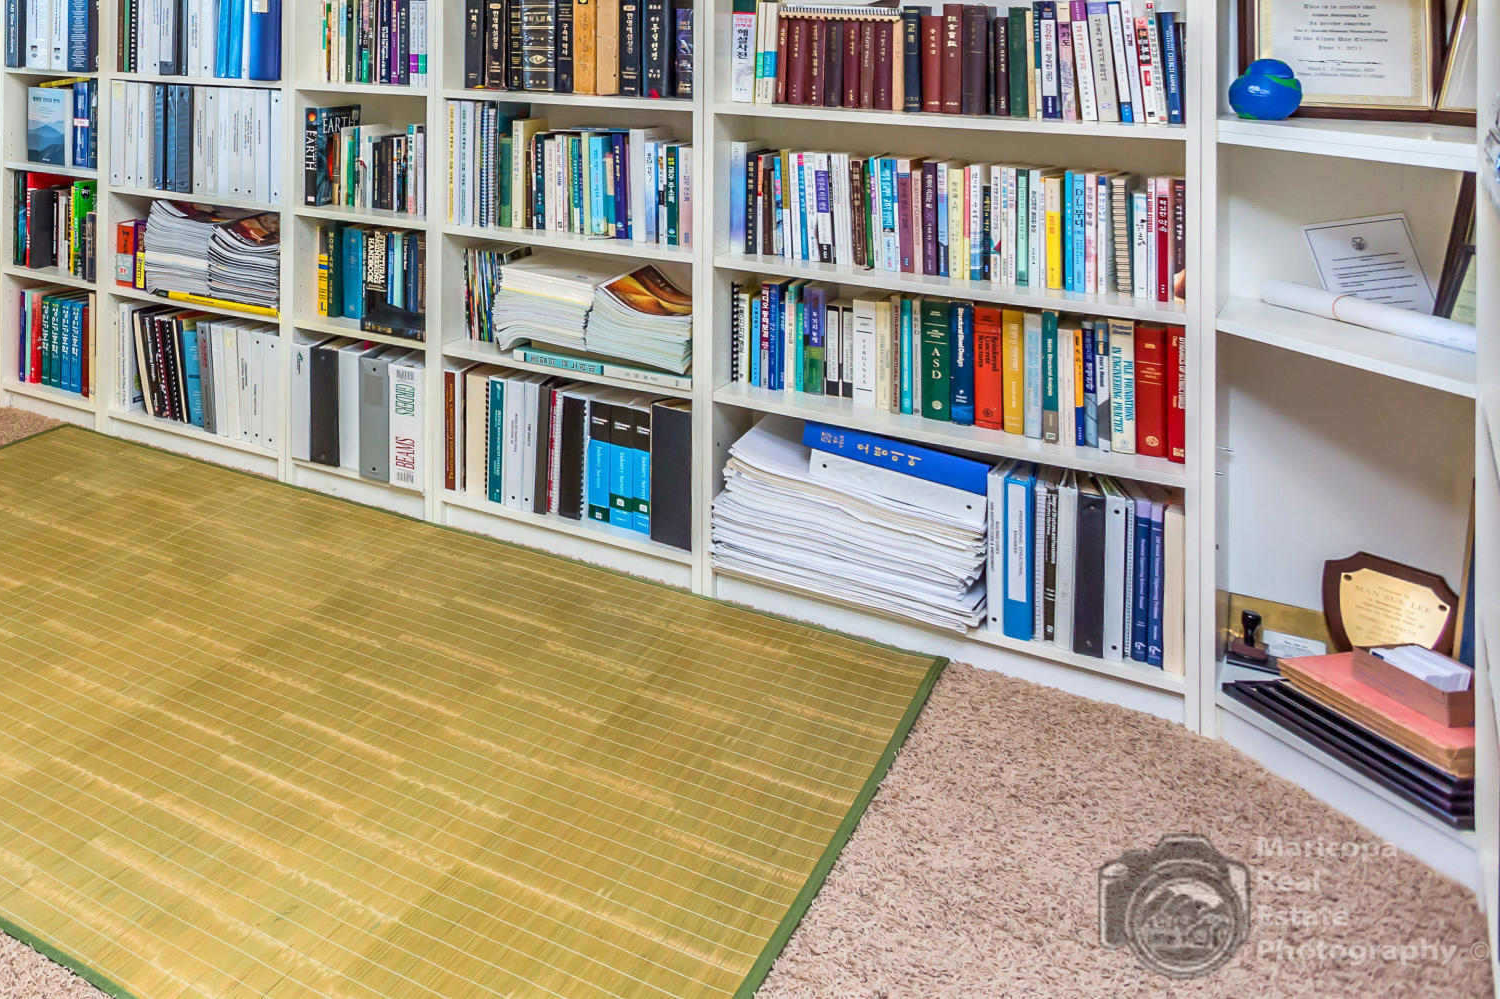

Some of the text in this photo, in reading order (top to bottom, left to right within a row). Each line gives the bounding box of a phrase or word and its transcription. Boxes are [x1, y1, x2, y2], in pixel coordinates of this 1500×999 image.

[306, 130, 315, 170] EARTH
[991, 336, 999, 372] Reinforced
[1112, 346, 1123, 433] IN ENGINEERING PRACTICE
[1123, 360, 1133, 421] PILE FOUNDATIONS
[396, 436, 415, 470] BEAMS
[857, 443, 922, 467] 오병이어
